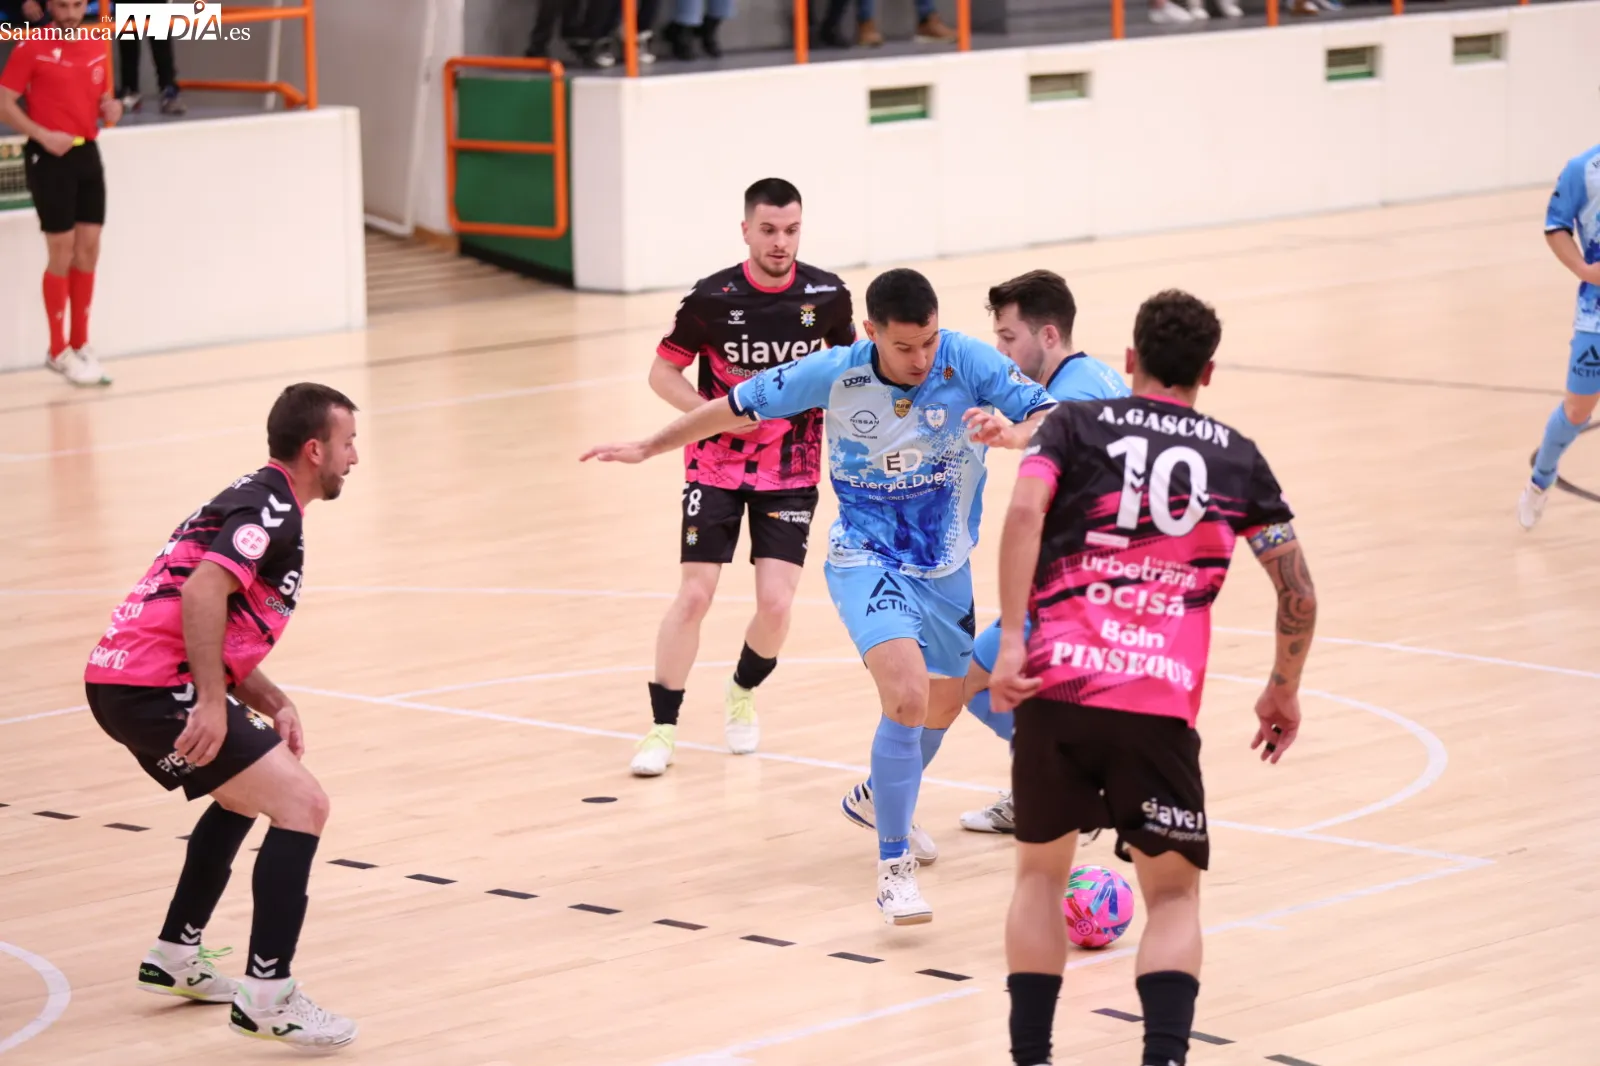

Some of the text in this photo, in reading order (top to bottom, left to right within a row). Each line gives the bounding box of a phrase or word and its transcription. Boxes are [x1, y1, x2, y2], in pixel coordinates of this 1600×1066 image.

[849, 418, 880, 426] NISSAN
[1097, 405, 1231, 448] A.GASCÓN
[687, 489, 703, 516] 8
[1106, 435, 1211, 537] 10
